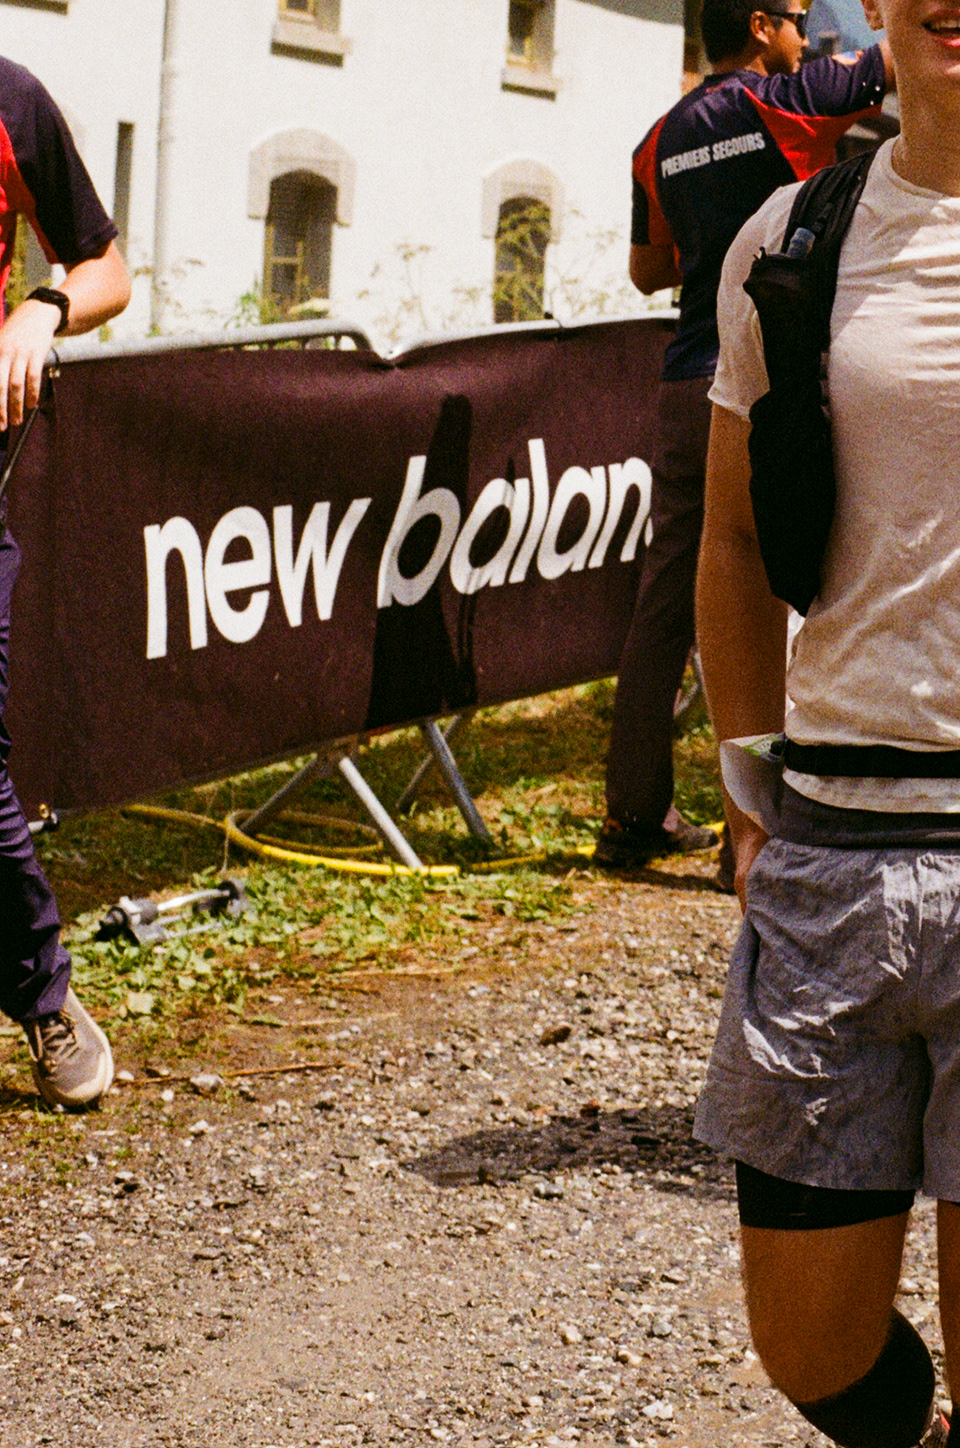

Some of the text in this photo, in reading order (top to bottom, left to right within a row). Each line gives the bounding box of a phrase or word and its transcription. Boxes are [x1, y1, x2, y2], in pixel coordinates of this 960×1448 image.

[661, 132, 766, 179] PREMIERS SECOURS
[143, 438, 653, 660] new balan
